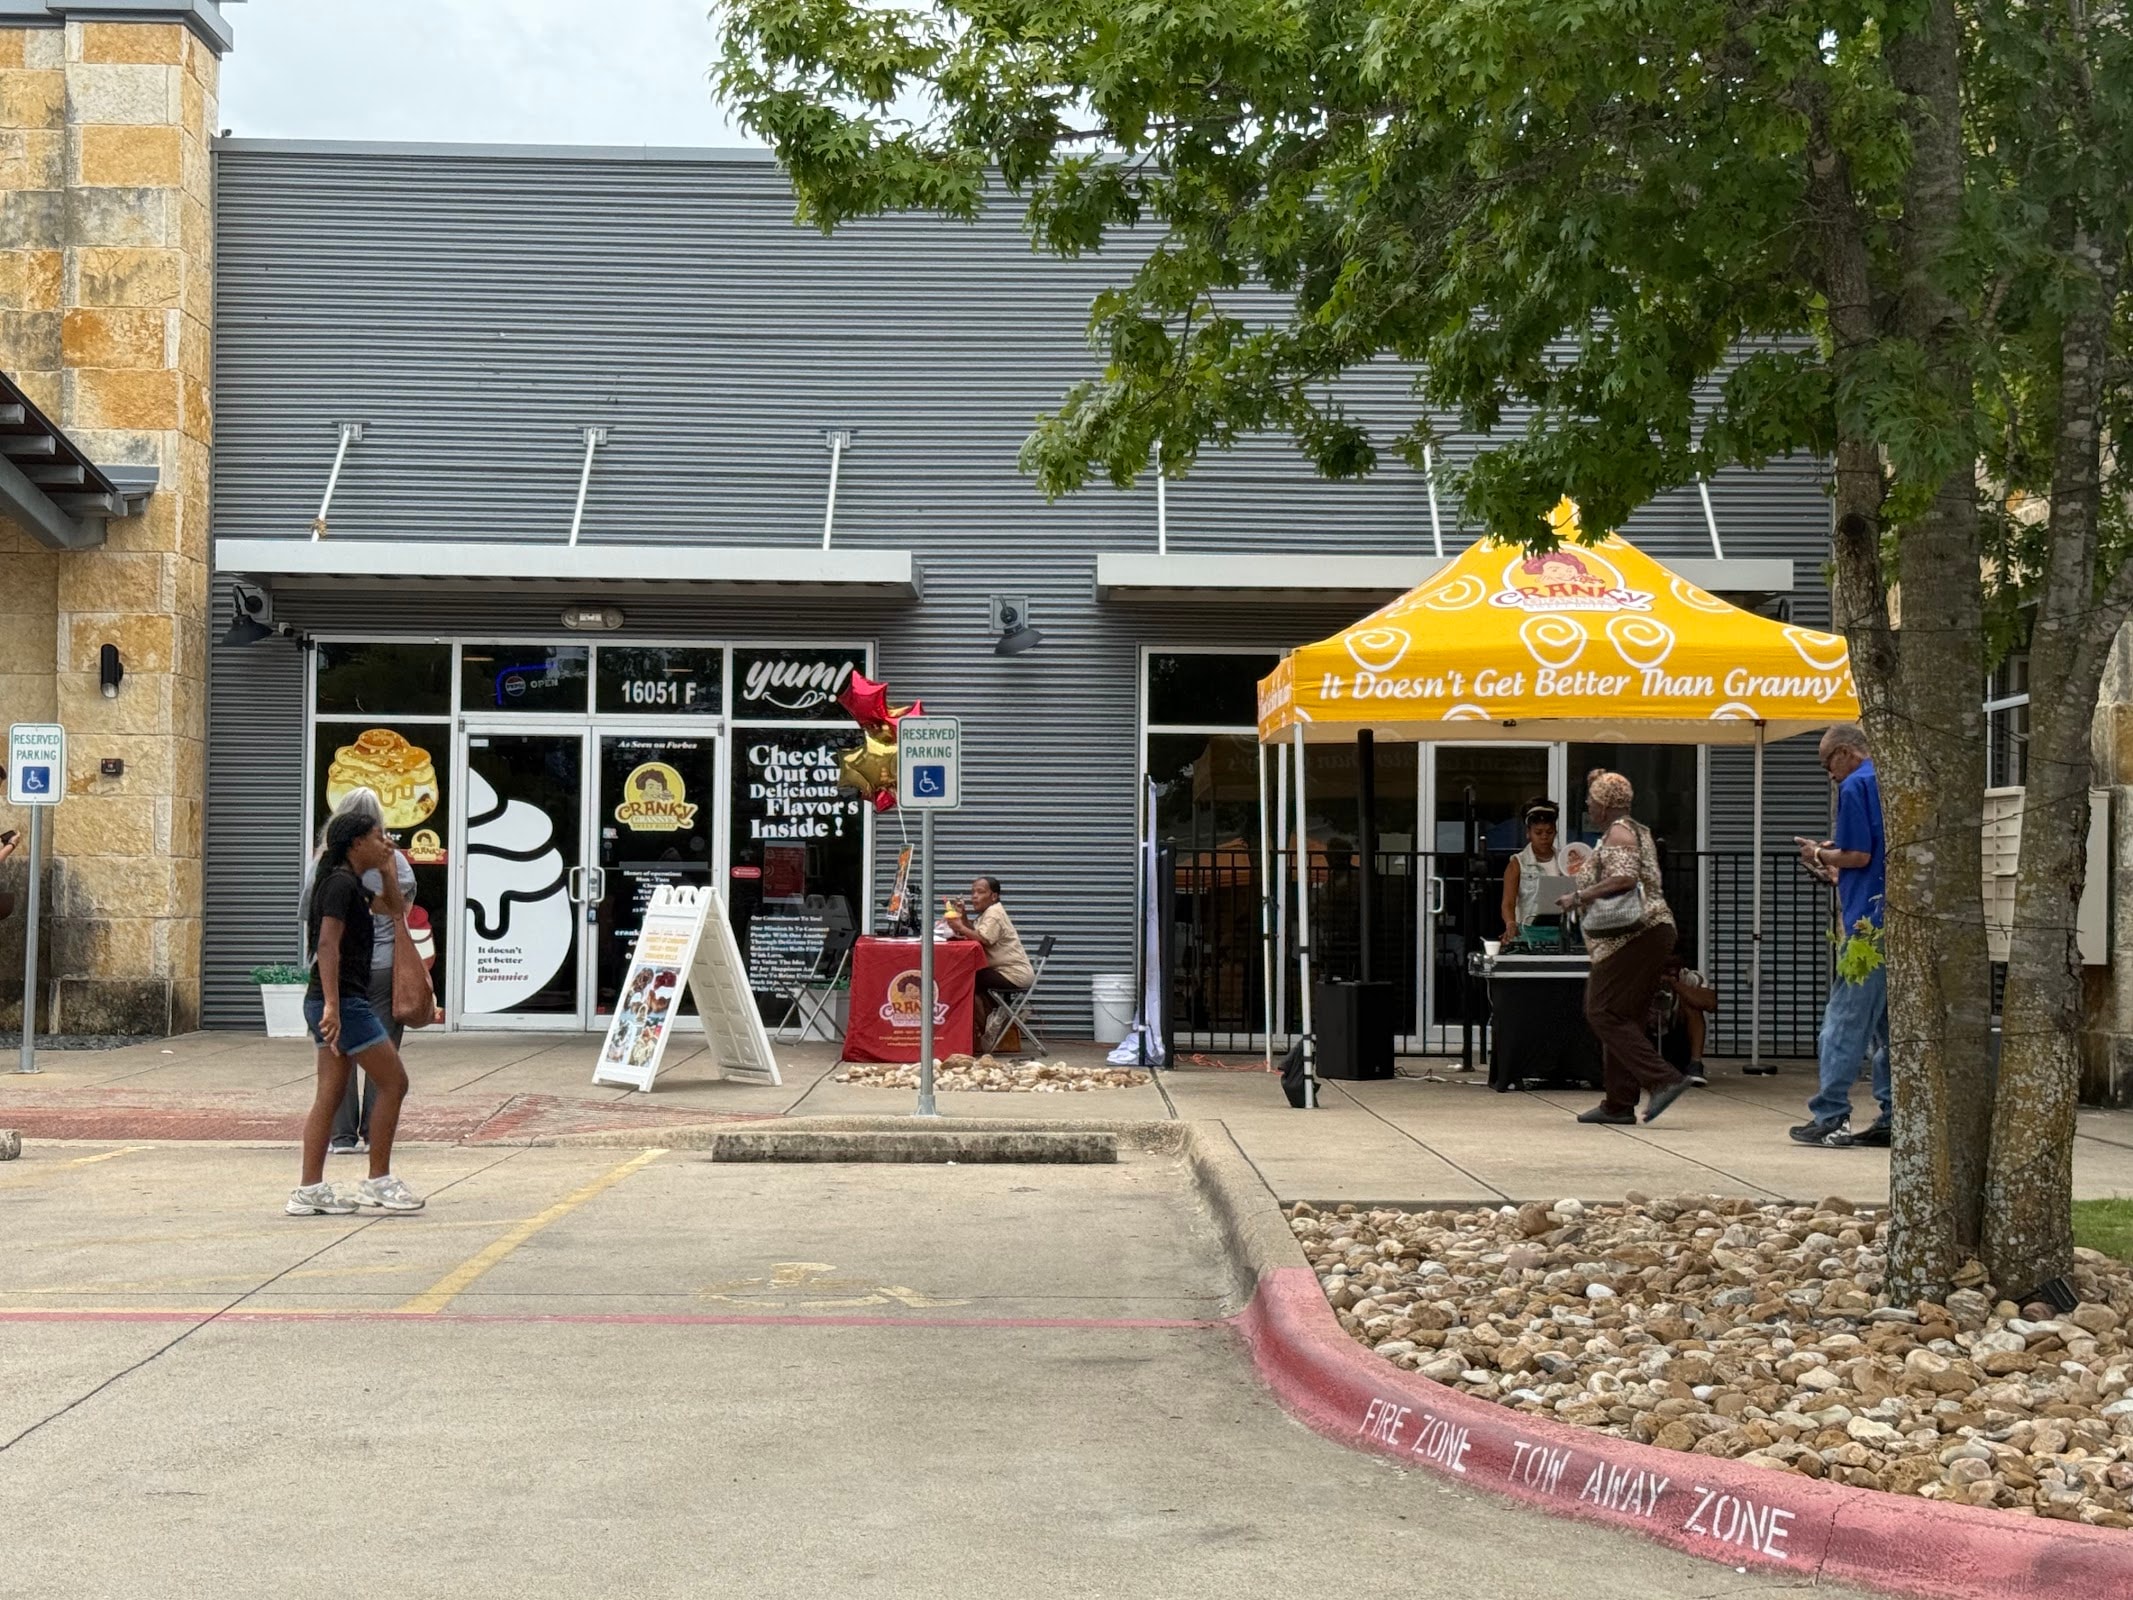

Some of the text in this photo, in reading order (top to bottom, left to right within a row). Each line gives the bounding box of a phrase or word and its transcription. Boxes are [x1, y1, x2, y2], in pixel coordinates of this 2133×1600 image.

[1495, 583, 1648, 609] CRANKY
[530, 679, 559, 688] OPEN
[743, 661, 854, 703] yum!
[1320, 672, 1344, 699] It
[1351, 670, 1465, 700] Doesn't
[1474, 668, 1526, 697] Get
[1534, 668, 1631, 697] Better
[1639, 667, 1714, 697] Than
[621, 680, 697, 704] 16051 F
[14, 734, 60, 745] RESERVED
[902, 729, 955, 740] RESERVED
[631, 740, 652, 748] Seen
[666, 741, 697, 749] Forbes
[906, 746, 952, 758] PARKING
[16, 750, 57, 760] PARKING
[749, 744, 837, 766] Check
[764, 765, 841, 783] Out ou
[750, 784, 838, 799] Delicious
[618, 801, 696, 826] CRANKY
[478, 946, 522, 954] It doesn't
[494, 956, 523, 964] better
[476, 972, 528, 983] grannies
[882, 1001, 947, 1022] CRANY
[1358, 1397, 1796, 1560] FIRE ZONE TOW AWAY ZONE
